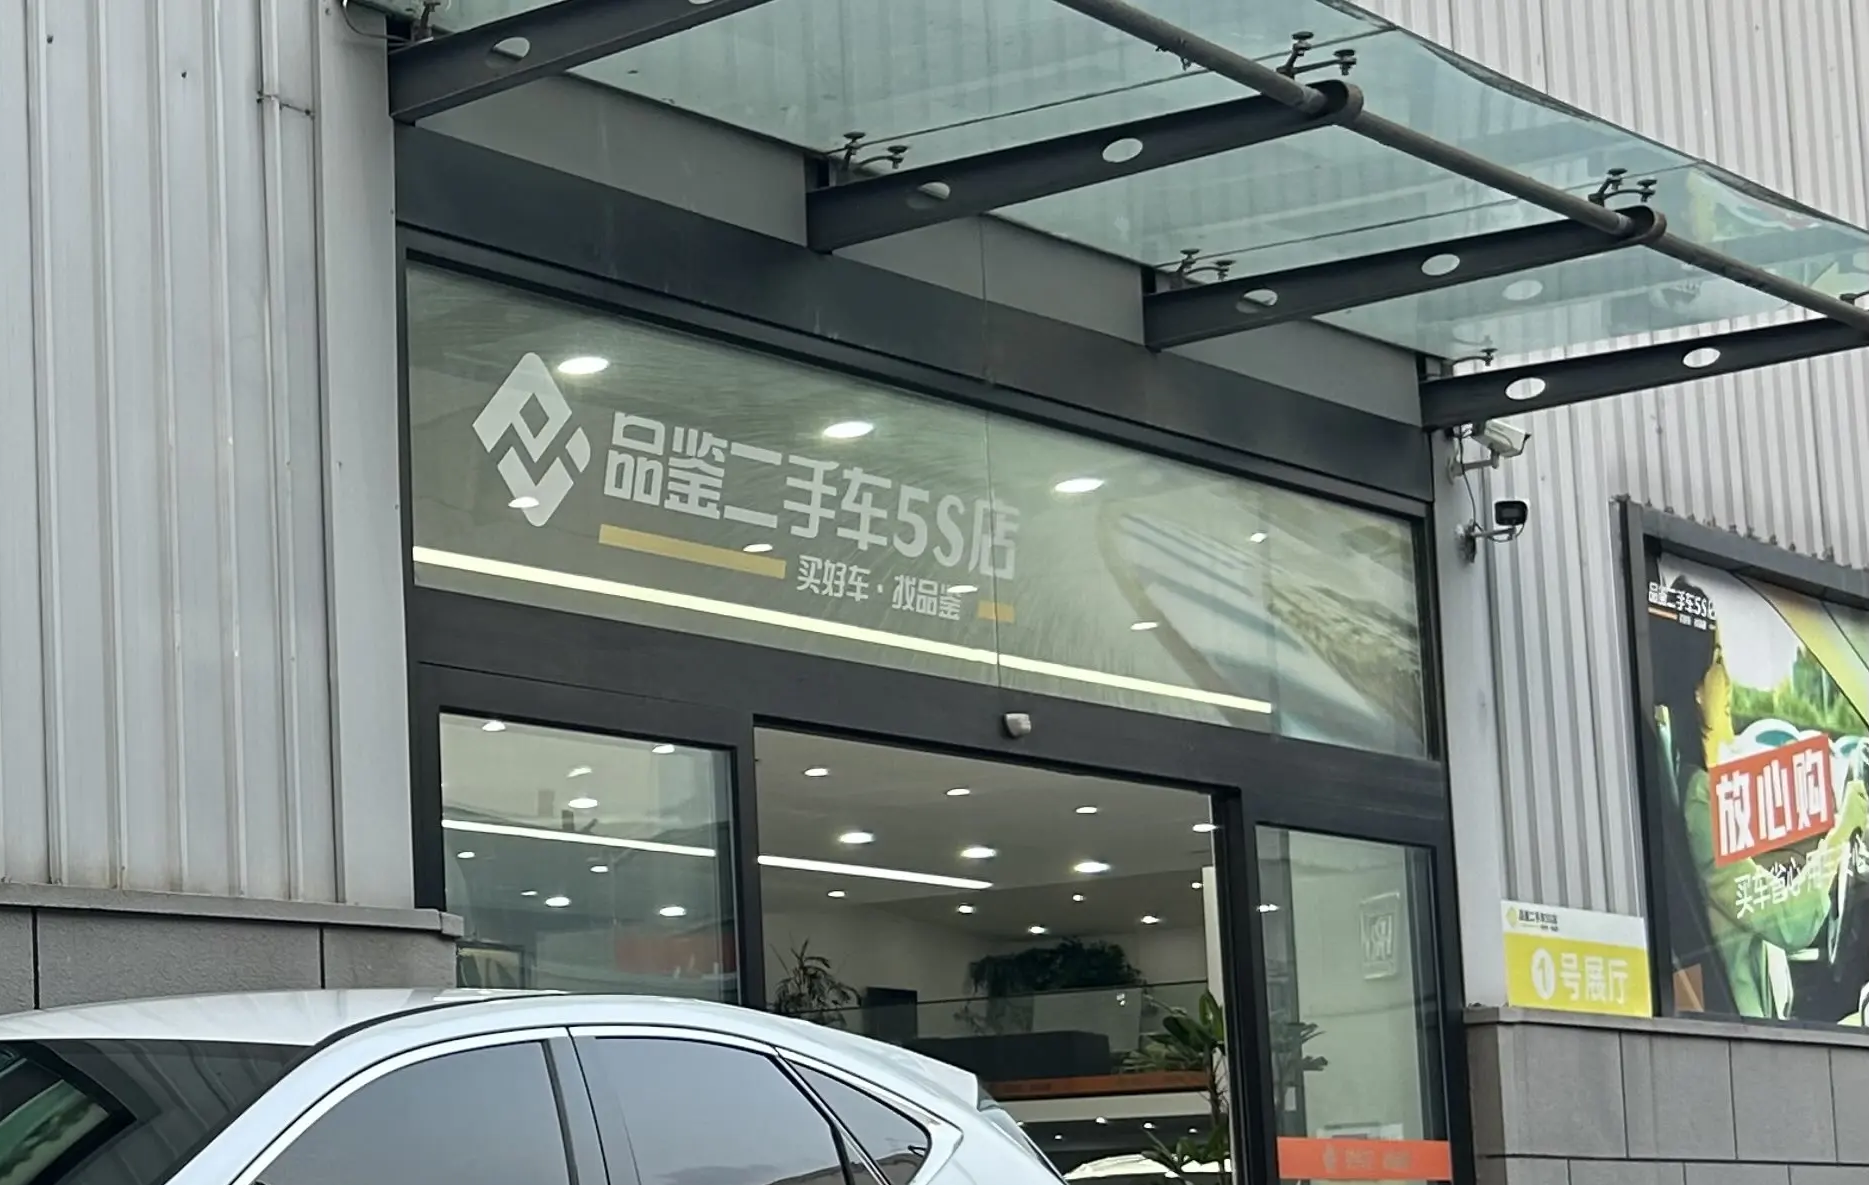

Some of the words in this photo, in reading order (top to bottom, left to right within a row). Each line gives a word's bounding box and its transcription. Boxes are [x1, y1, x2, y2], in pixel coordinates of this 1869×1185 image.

[602, 411, 1021, 581] 品鉴二手车5S店
[1715, 746, 1828, 857] 放心购
[1734, 856, 1801, 920] 买车省心
